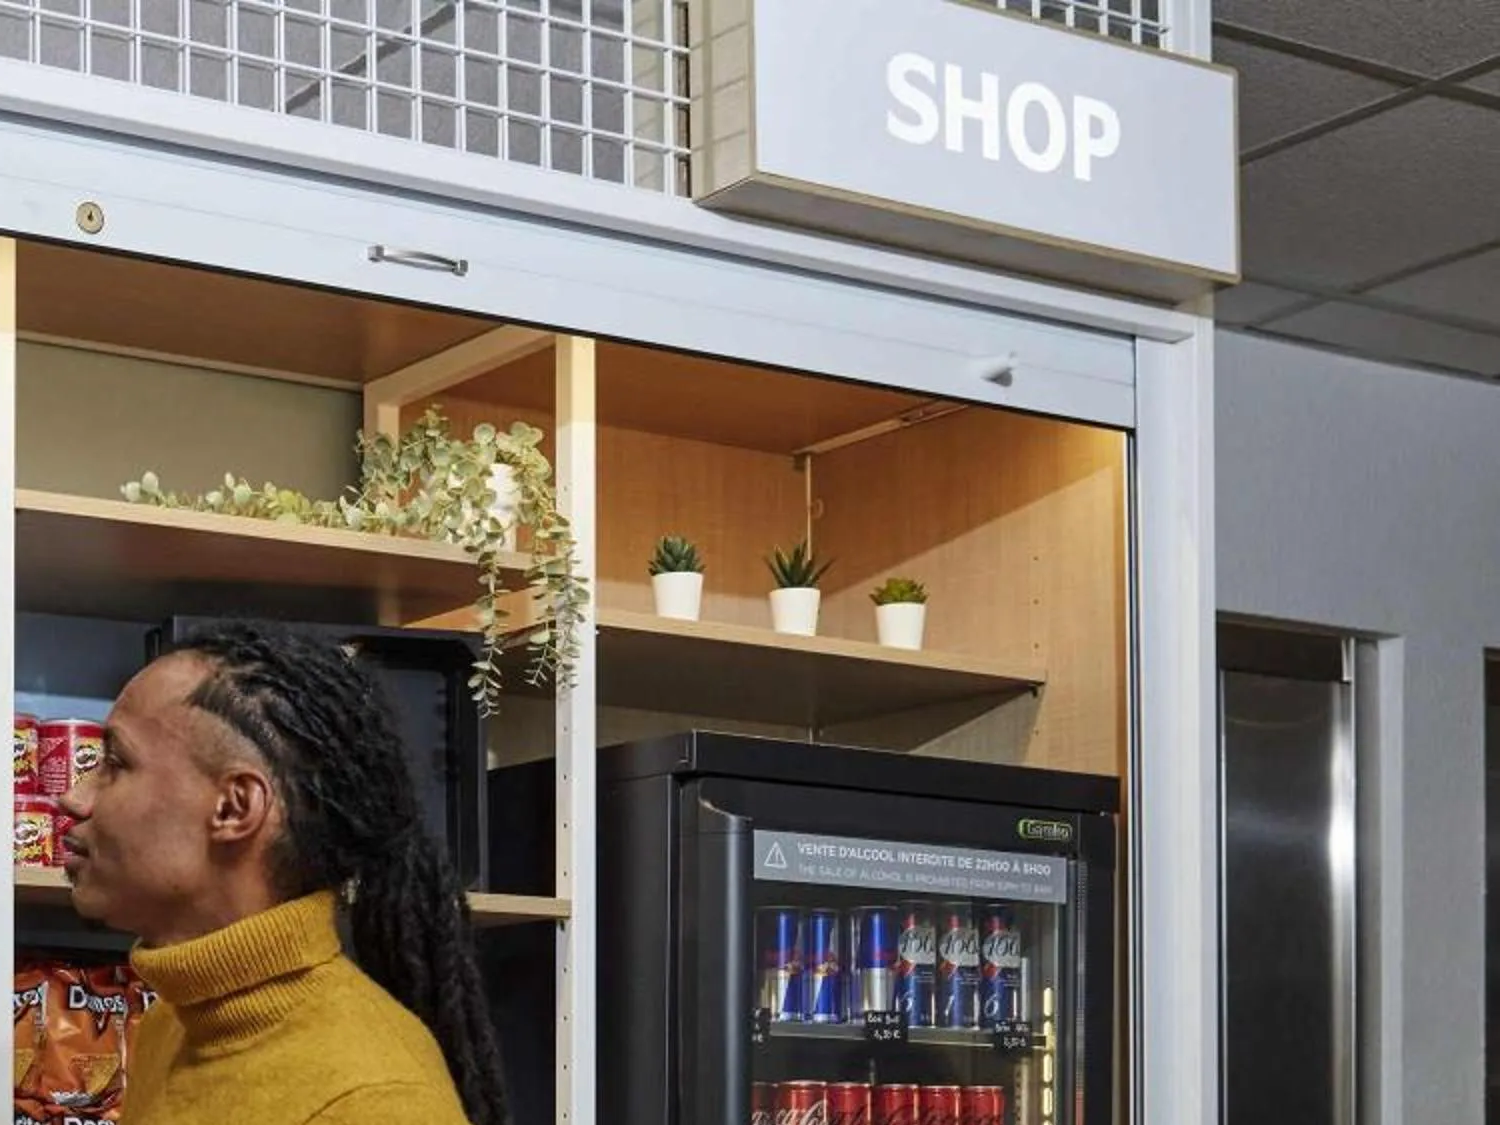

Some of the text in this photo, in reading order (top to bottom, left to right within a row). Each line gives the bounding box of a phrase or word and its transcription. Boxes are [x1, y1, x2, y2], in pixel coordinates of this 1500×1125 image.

[886, 52, 1122, 182] SHOP
[797, 842, 837, 858] VENTE
[839, 846, 896, 863] D'ALCOOL
[897, 852, 956, 868] INTERDITE
